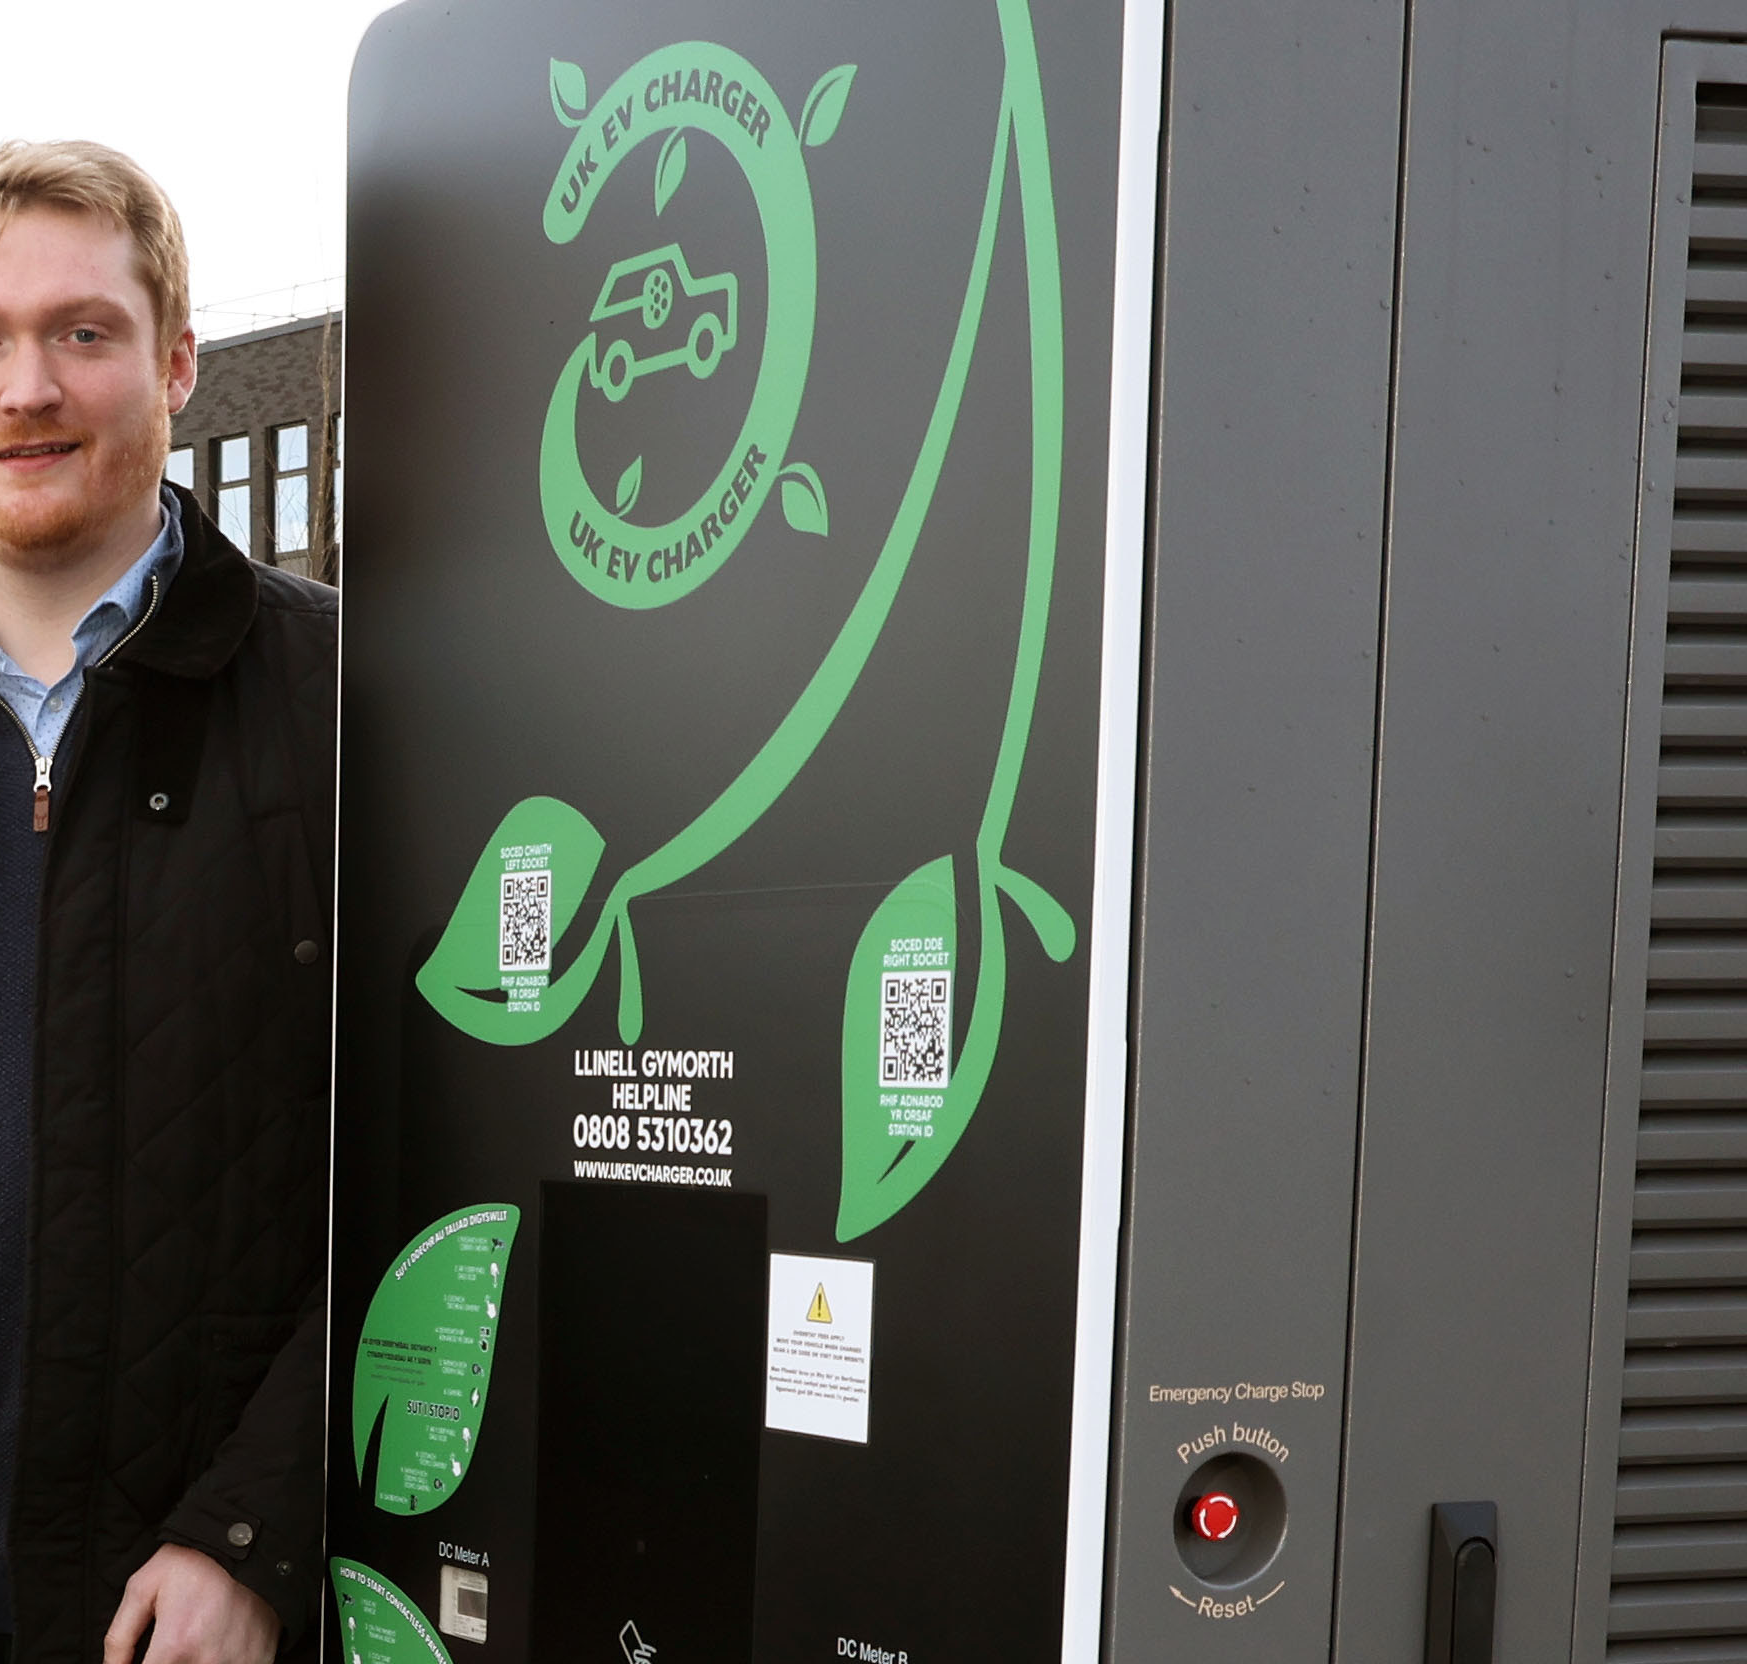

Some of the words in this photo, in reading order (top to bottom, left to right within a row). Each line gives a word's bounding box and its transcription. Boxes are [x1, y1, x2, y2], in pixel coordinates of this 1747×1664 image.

[560, 152, 598, 214] UK
[601, 101, 637, 152] EV
[644, 68, 771, 149] CHARGER
[569, 510, 605, 569] UK
[606, 547, 640, 584] EV
[646, 443, 767, 583] CHARGER
[890, 938, 922, 952] SOCED
[924, 937, 943, 951] DDE
[883, 953, 911, 967] RIGHT
[912, 952, 949, 966] SOCKET
[574, 1050, 637, 1077] LLINELL
[641, 1050, 734, 1079] GYMORTH
[612, 1083, 692, 1112] HELPLINE
[879, 1094, 898, 1107] RHIF
[900, 1094, 944, 1108] ADNABOD
[890, 1109, 902, 1120] YR
[904, 1109, 932, 1122] ORSAF
[573, 1114, 630, 1150] 0808
[637, 1116, 732, 1155] 5310362
[888, 1123, 922, 1136] STATION
[924, 1124, 934, 1137] ID
[574, 1160, 732, 1187] WWW.UKEVCHARGER.CO.UK
[1149, 1383, 1232, 1404] Emergency
[1234, 1382, 1289, 1404] Charge
[1291, 1380, 1325, 1401] Stop
[407, 1400, 422, 1416] SUT
[429, 1404, 460, 1422] STOPIO
[1175, 1424, 1227, 1464] Push
[1232, 1423, 1290, 1462] button
[438, 1541, 453, 1559] DC
[454, 1545, 480, 1565] Meter
[481, 1552, 490, 1568] A
[339, 1567, 357, 1579] HOW
[357, 1572, 366, 1584] TO
[367, 1578, 386, 1596] START
[385, 1591, 425, 1637] CONTACTLESS
[1198, 1594, 1256, 1619] Reset
[837, 1637, 857, 1658] DC
